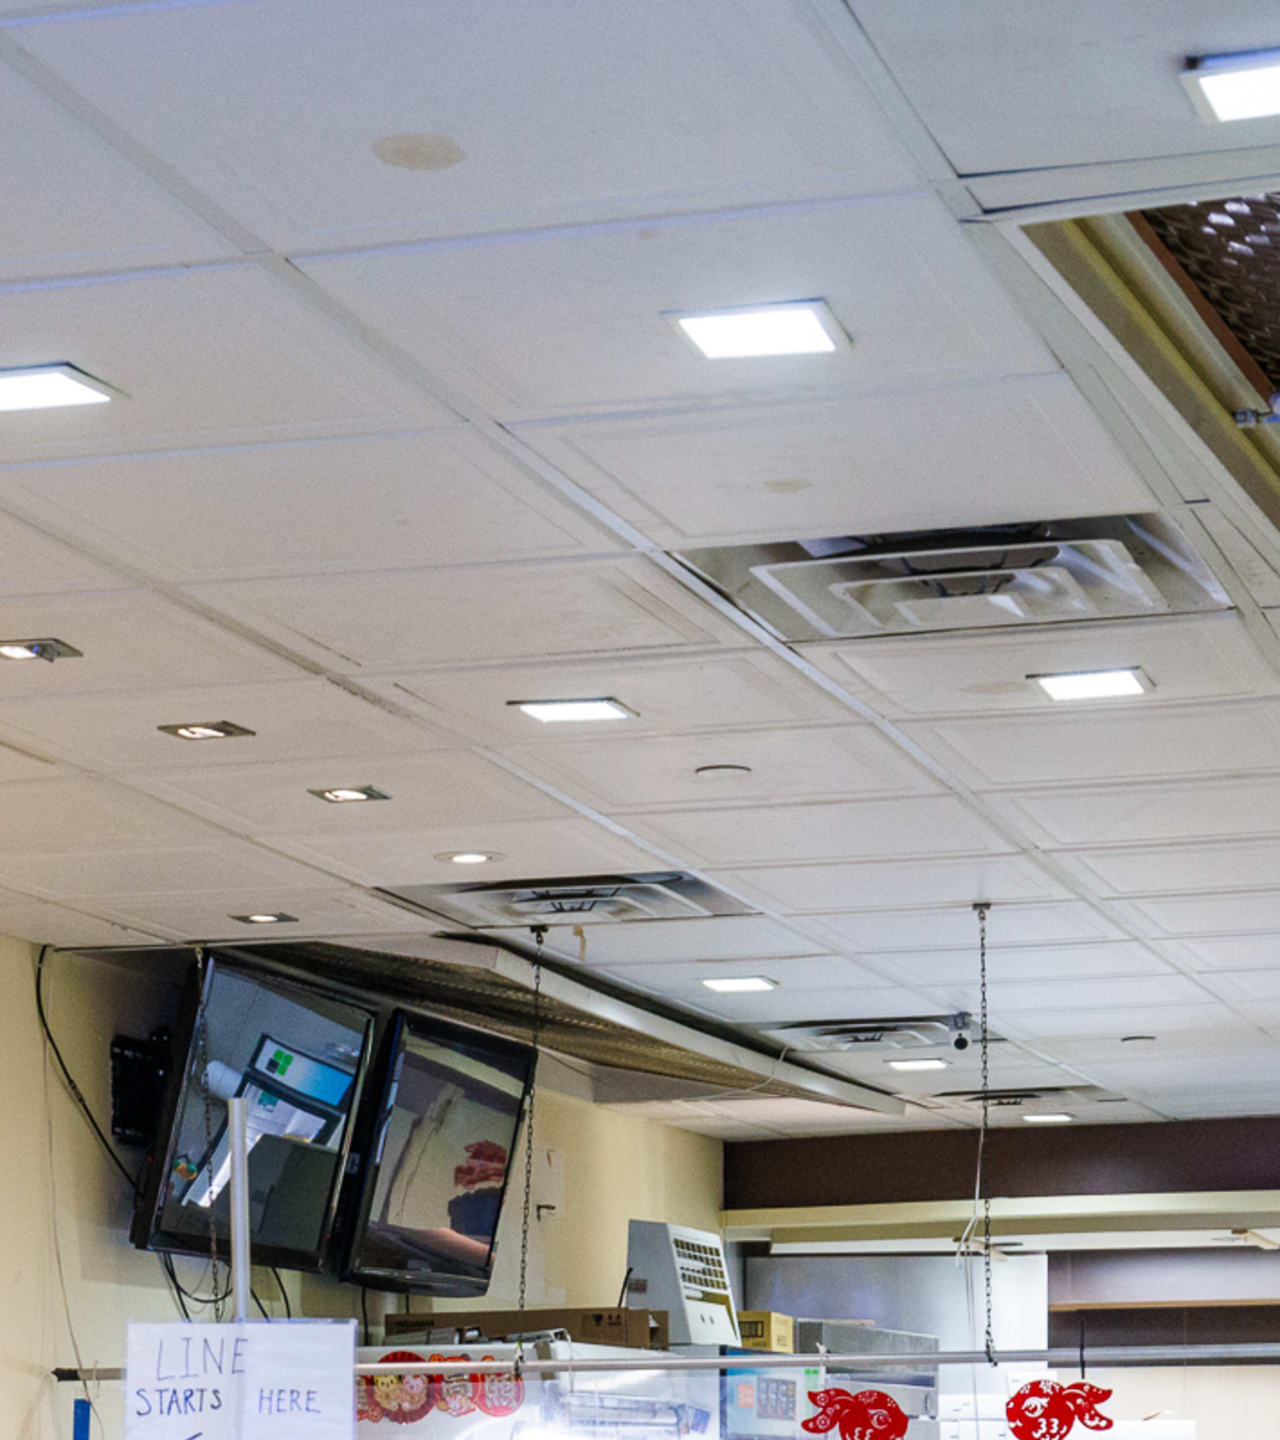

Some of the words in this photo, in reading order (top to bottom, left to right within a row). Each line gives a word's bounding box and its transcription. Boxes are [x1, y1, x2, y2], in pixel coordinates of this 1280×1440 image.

[156, 1337, 249, 1381] LINE
[136, 1388, 222, 1416] STARTS
[258, 1388, 322, 1416] HERE
